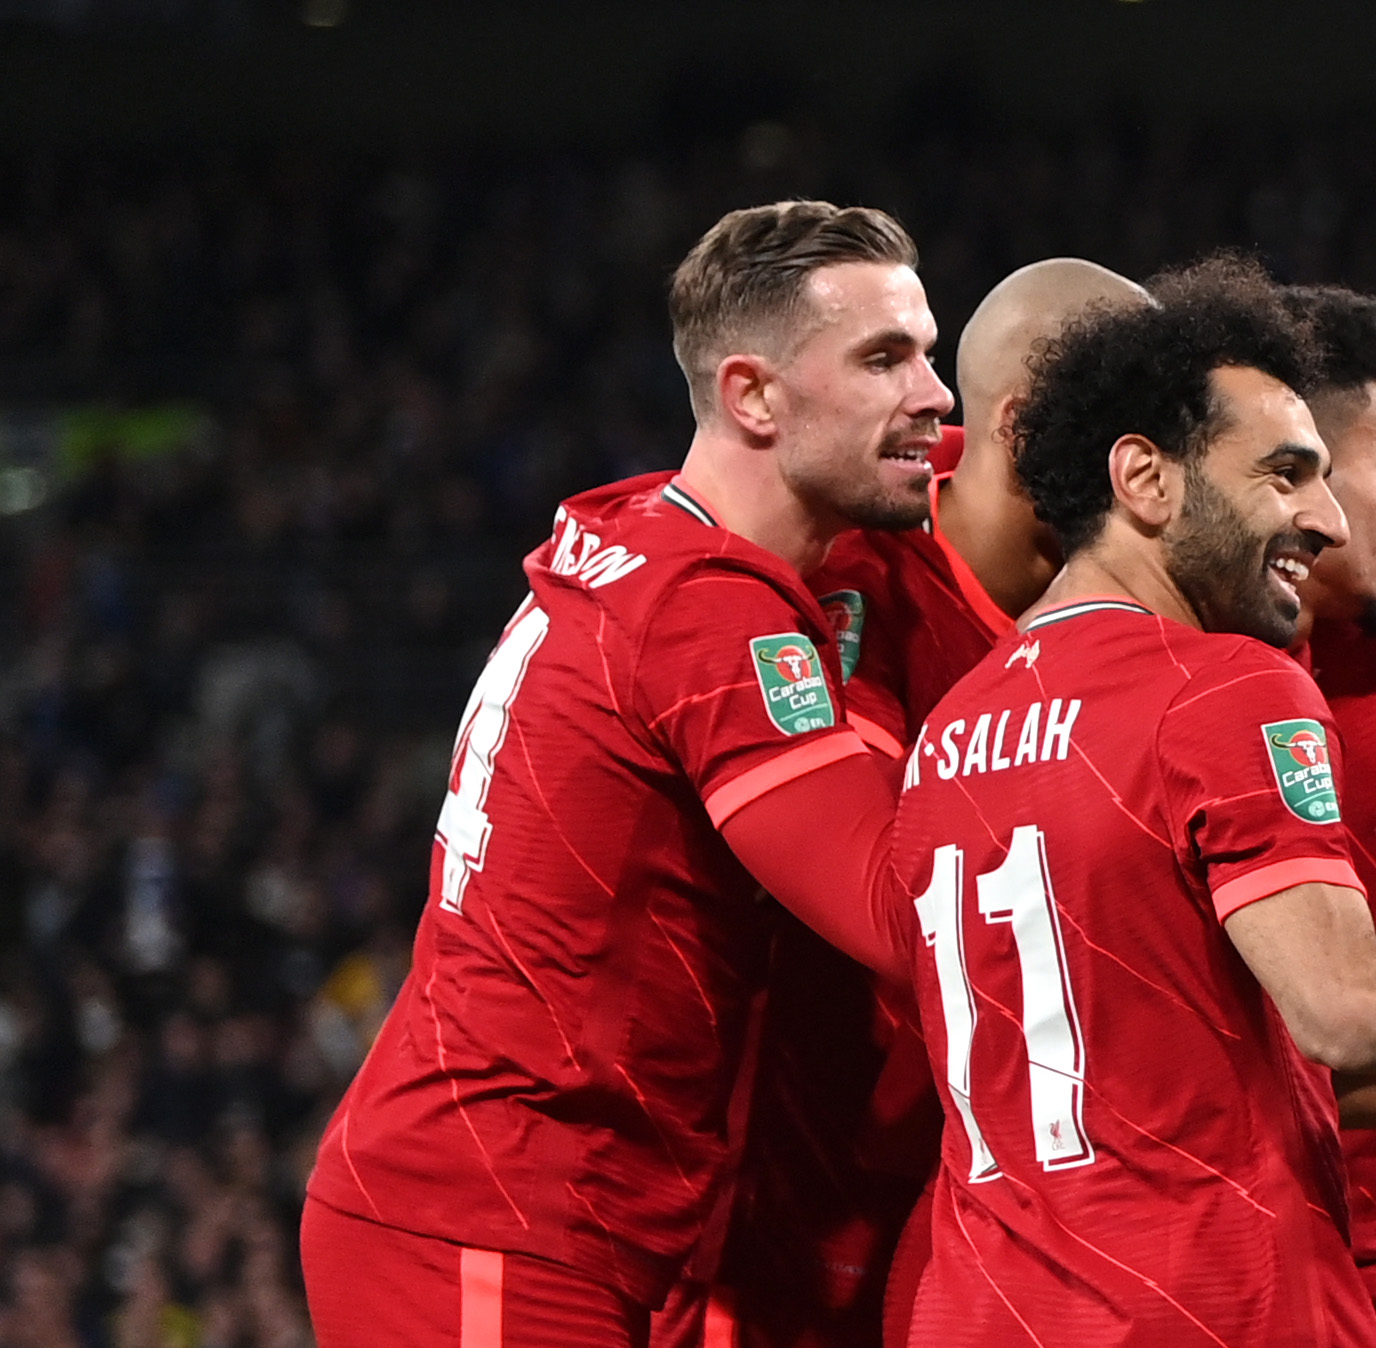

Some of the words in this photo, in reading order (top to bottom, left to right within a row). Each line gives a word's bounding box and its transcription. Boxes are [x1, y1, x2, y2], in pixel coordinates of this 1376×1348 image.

[768, 675, 822, 703] Carabao
[789, 691, 818, 710] Cup
[1303, 777, 1333, 794] Cup
[912, 824, 1096, 1184] 11
